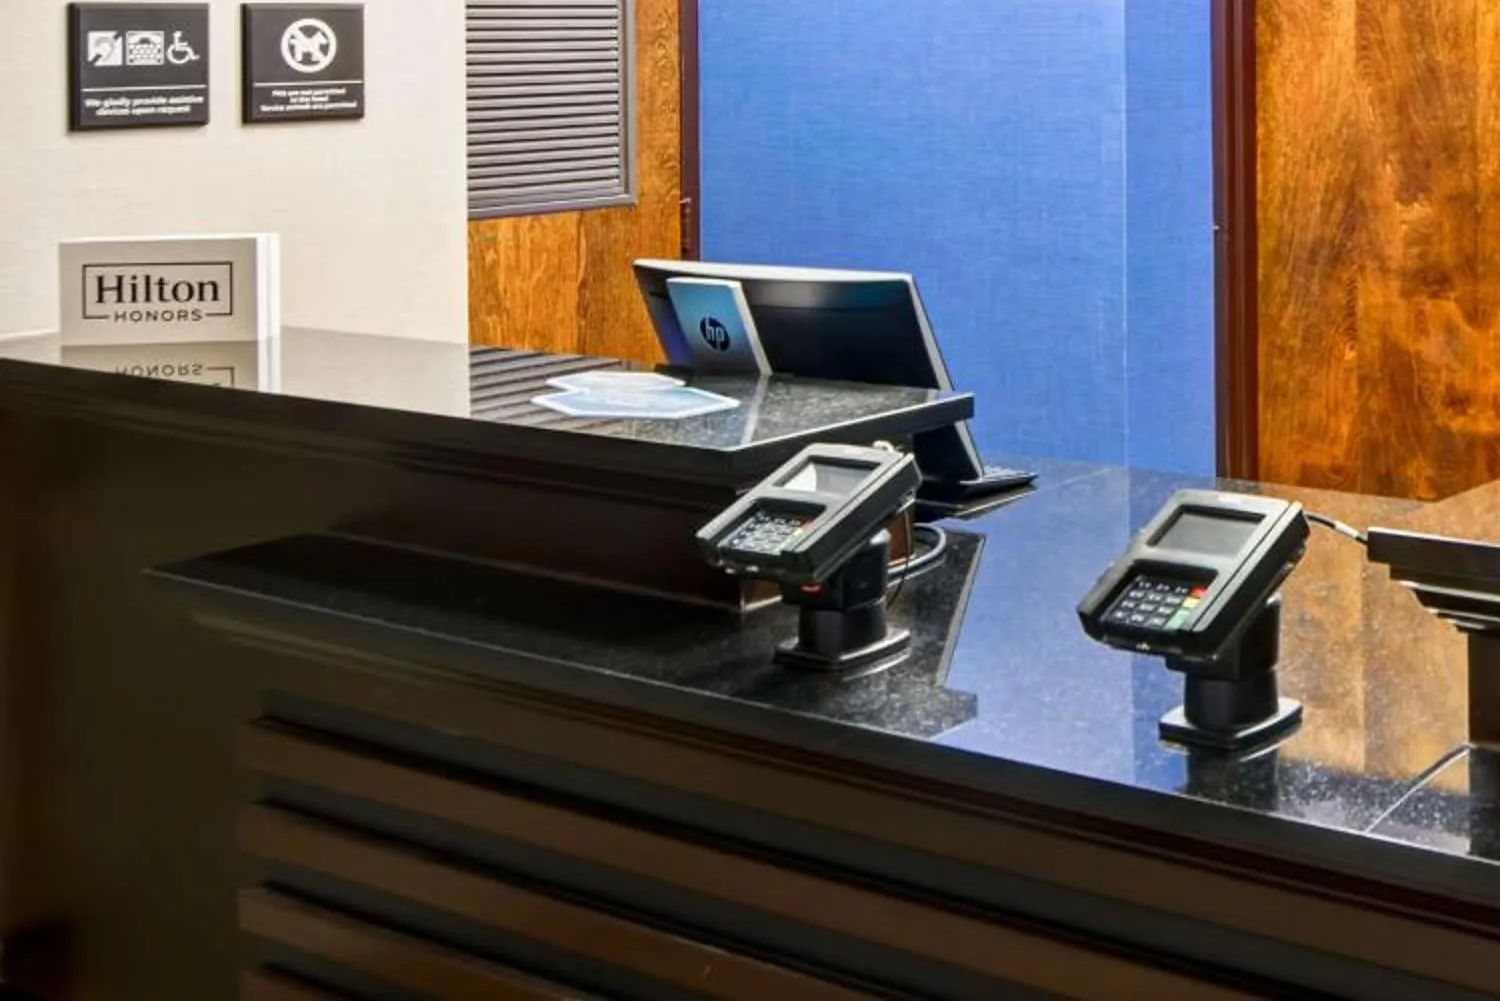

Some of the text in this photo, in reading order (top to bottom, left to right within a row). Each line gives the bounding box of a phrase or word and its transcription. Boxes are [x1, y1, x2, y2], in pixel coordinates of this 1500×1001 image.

[95, 274, 220, 305] Hilton
[113, 308, 204, 323] HONORS
[703, 316, 727, 351] hp
